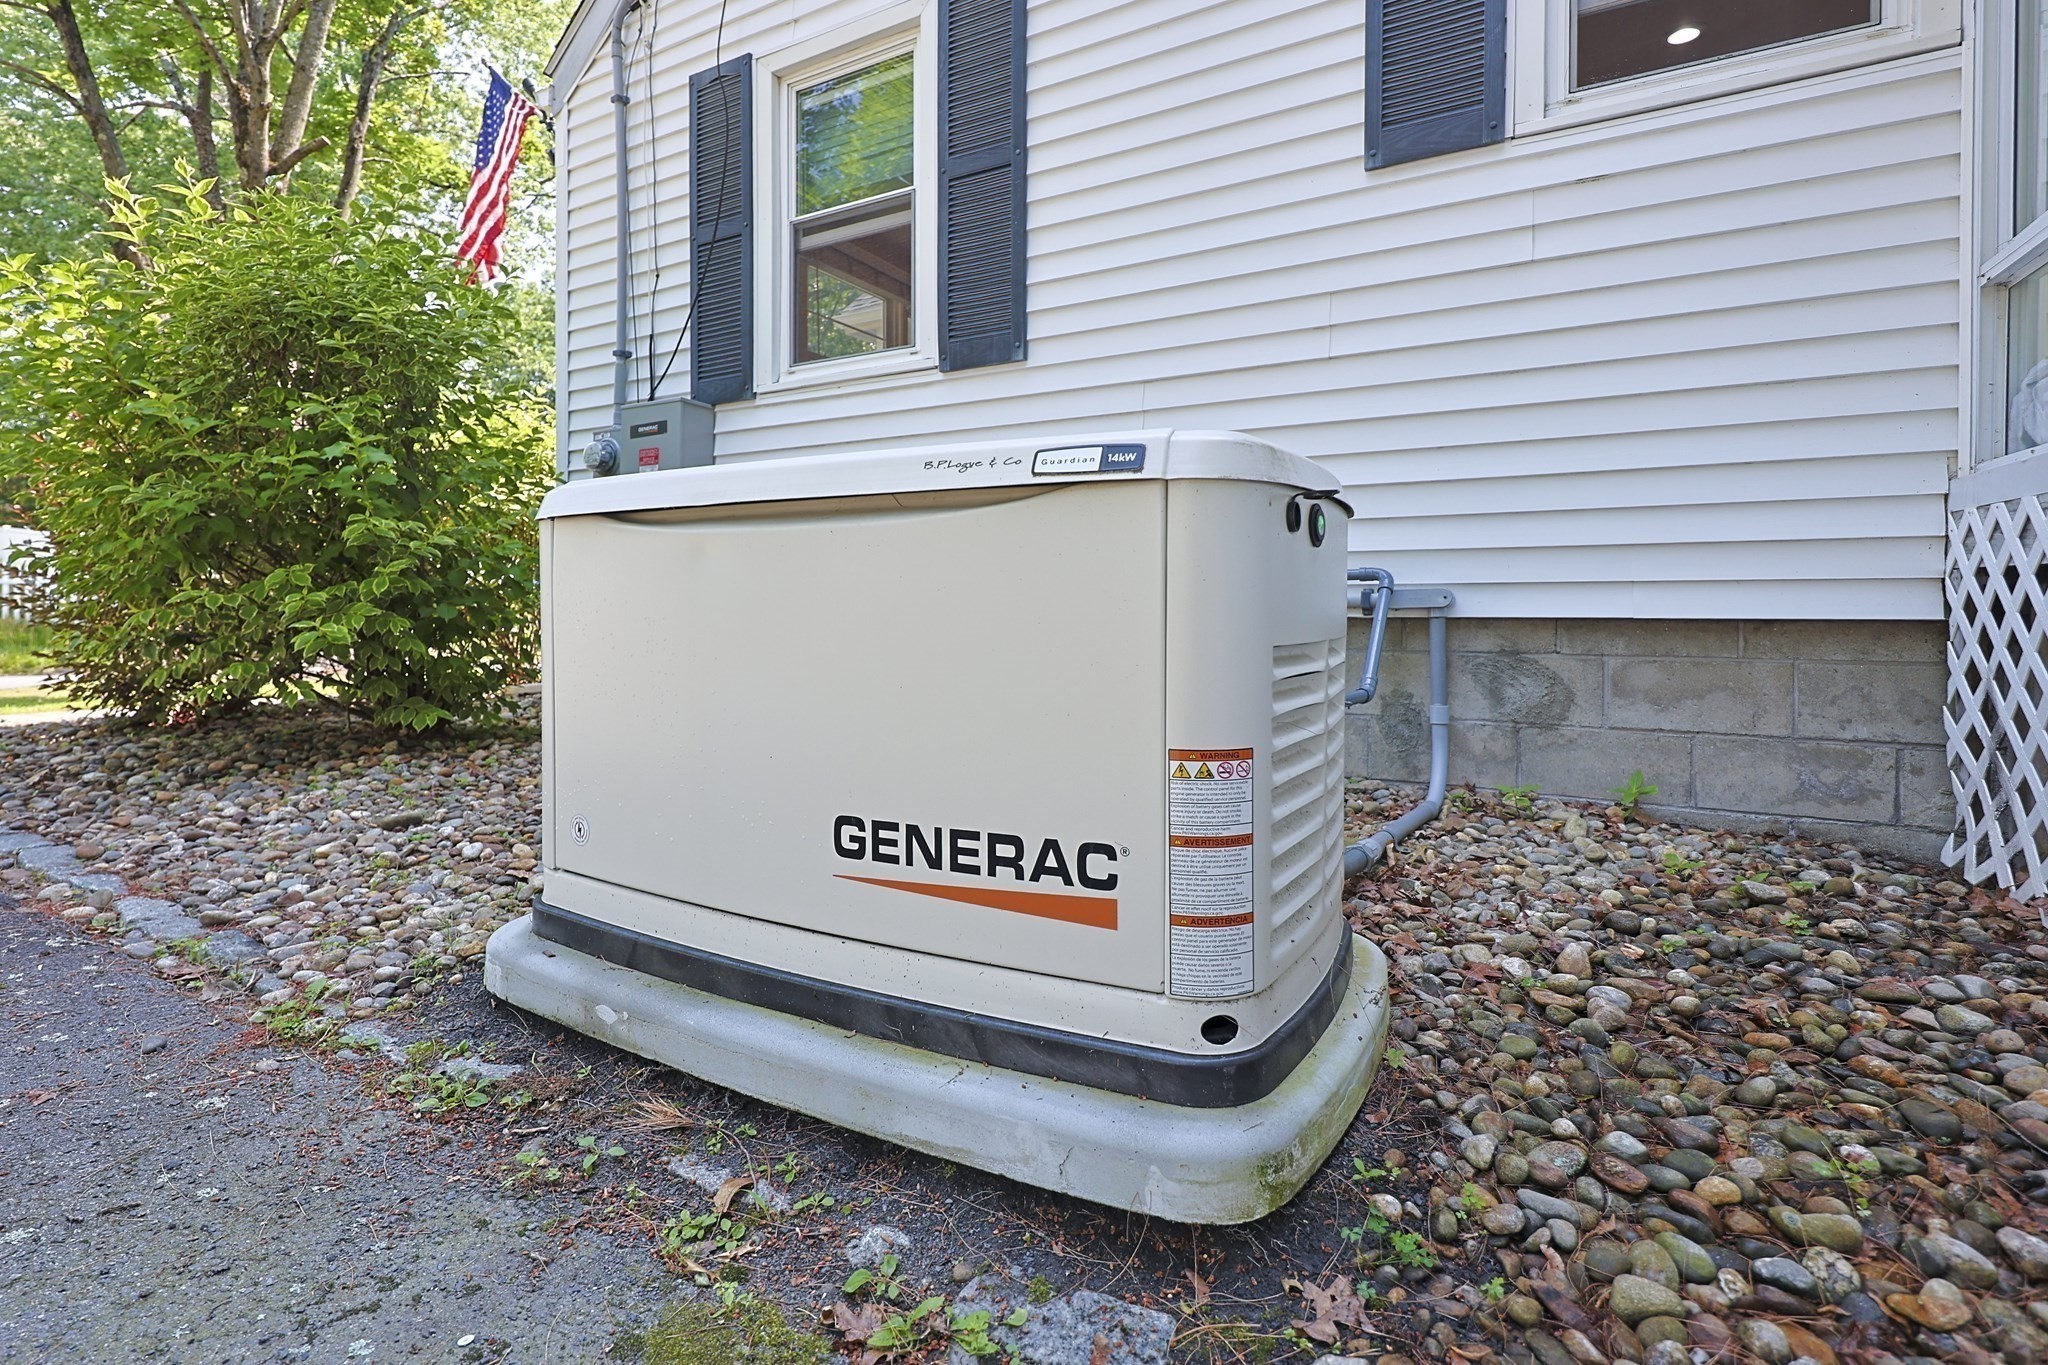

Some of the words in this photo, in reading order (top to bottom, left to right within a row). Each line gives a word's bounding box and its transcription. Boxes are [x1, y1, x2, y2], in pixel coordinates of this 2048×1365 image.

[988, 457, 998, 468] &
[1003, 457, 1022, 466] Co
[1041, 456, 1096, 466] Guardian
[1107, 452, 1138, 462] 14kW
[1200, 752, 1240, 760] WARNING
[1184, 836, 1250, 846] AVERTISSEMENT
[1190, 916, 1248, 925] ADVERTENCIA
